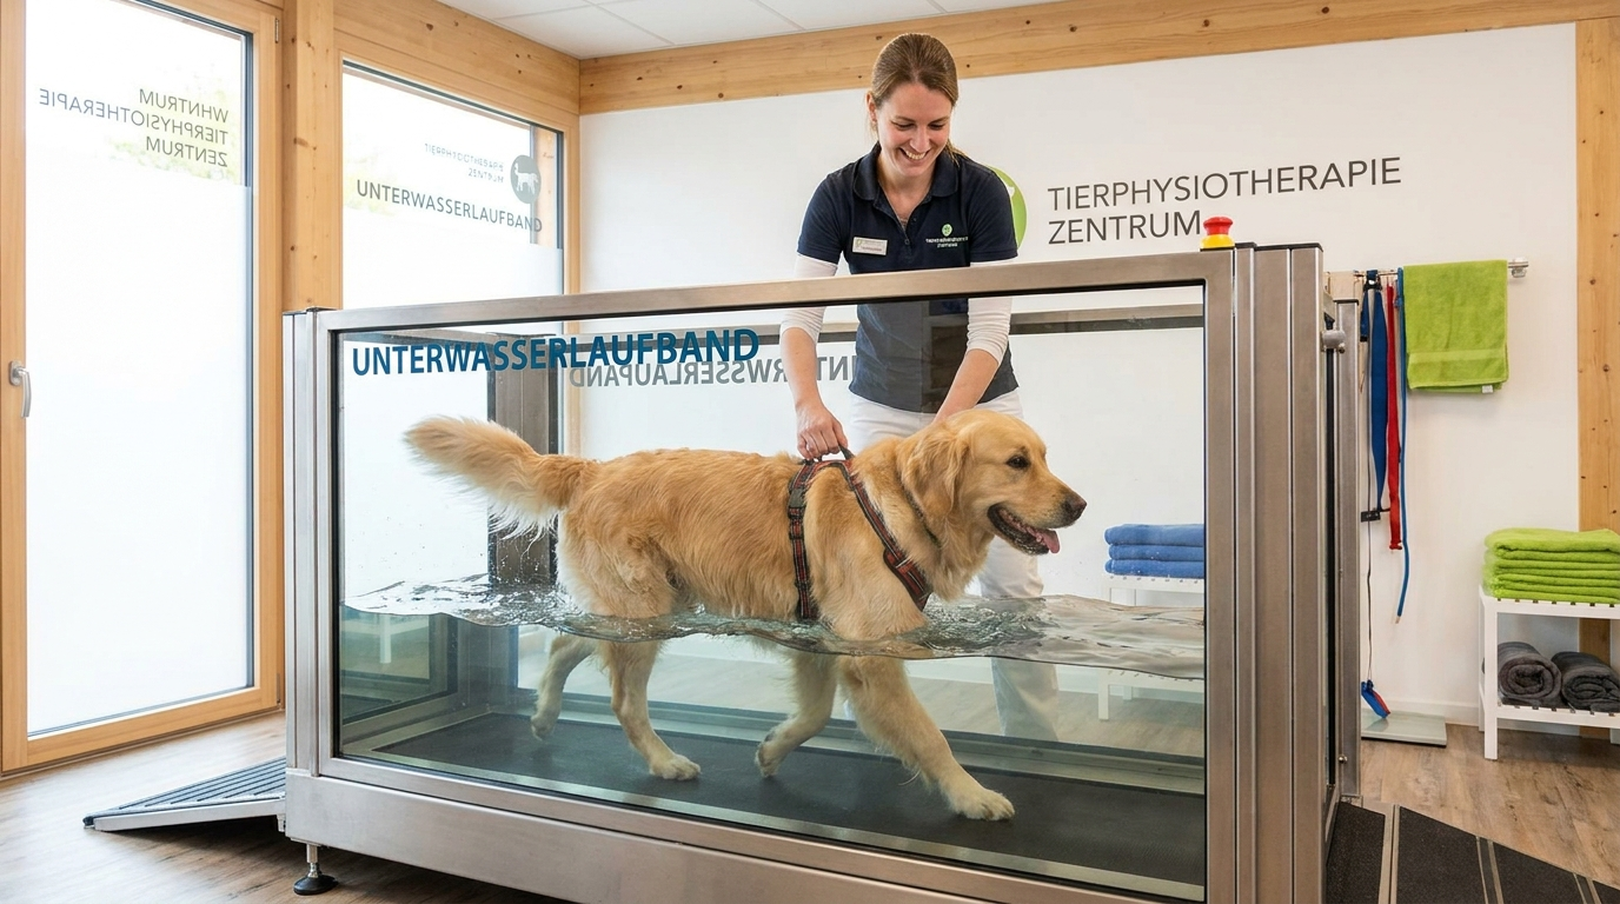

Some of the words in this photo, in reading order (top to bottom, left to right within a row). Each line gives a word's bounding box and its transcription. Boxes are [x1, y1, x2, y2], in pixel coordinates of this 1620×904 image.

[357, 179, 543, 232] UNTERWASSERLAUFBAND
[1047, 156, 1402, 211] TIERPHYSIOTHERAPIE
[1048, 209, 1201, 245] ZENTRUM
[352, 328, 759, 376] UNTERWASSERLAUFBAND
